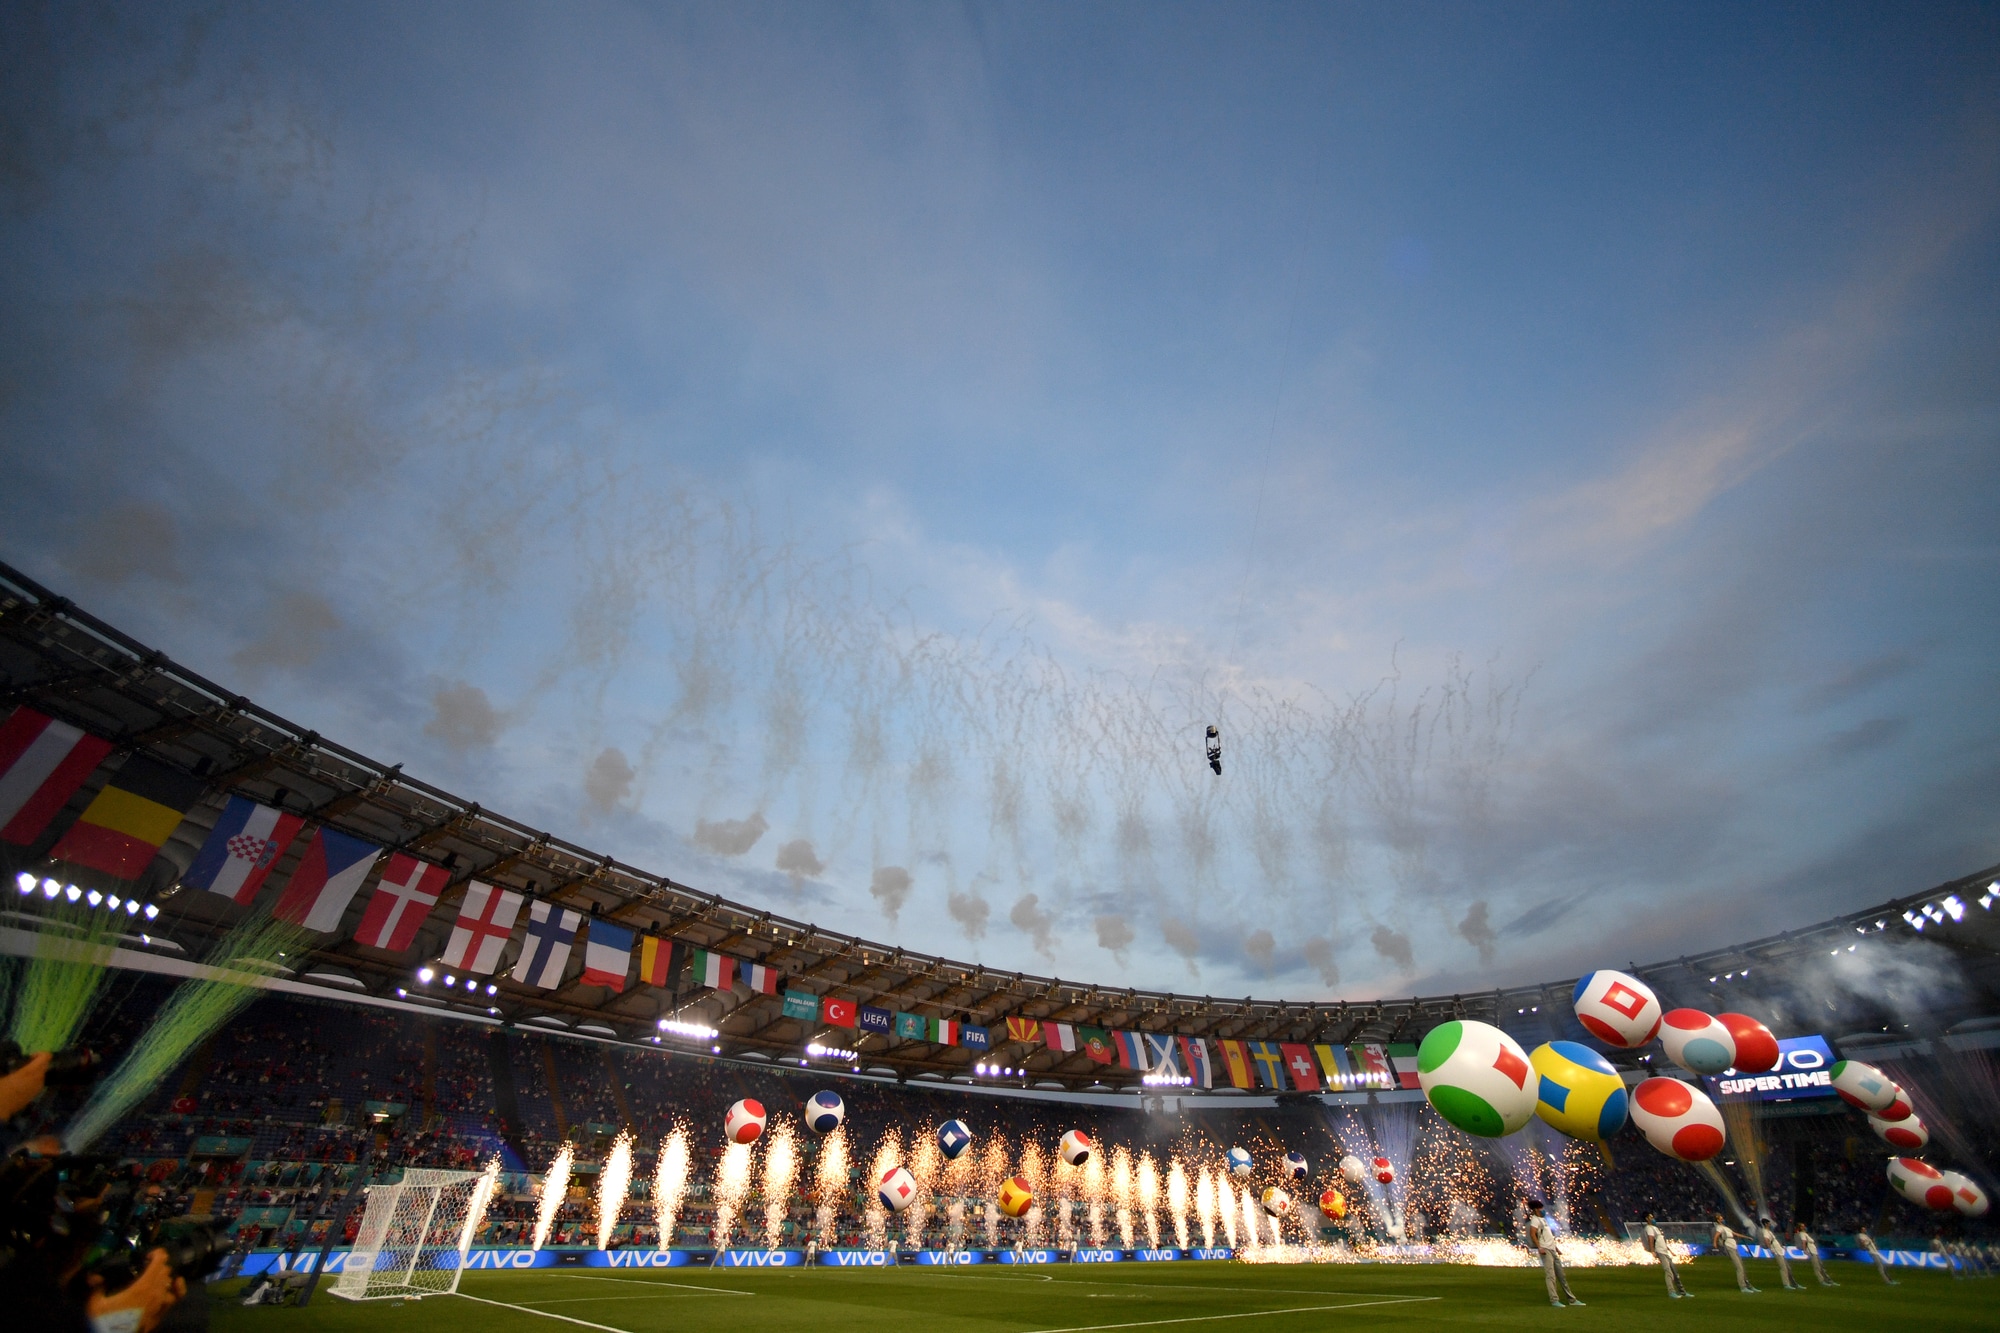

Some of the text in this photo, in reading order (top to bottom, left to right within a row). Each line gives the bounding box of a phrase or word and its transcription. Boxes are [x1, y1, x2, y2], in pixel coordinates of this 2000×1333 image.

[863, 1012, 888, 1026] UEFA
[966, 1031, 986, 1043] FIFA
[1719, 1070, 1831, 1095] SUPER TIME
[606, 1250, 671, 1267] VIVO
[730, 1251, 786, 1266] VIVO
[837, 1251, 885, 1266] VIVO
[1080, 1251, 1114, 1262] VIVO
[1143, 1250, 1173, 1261] VIVO
[1198, 1249, 1226, 1260] VIVO
